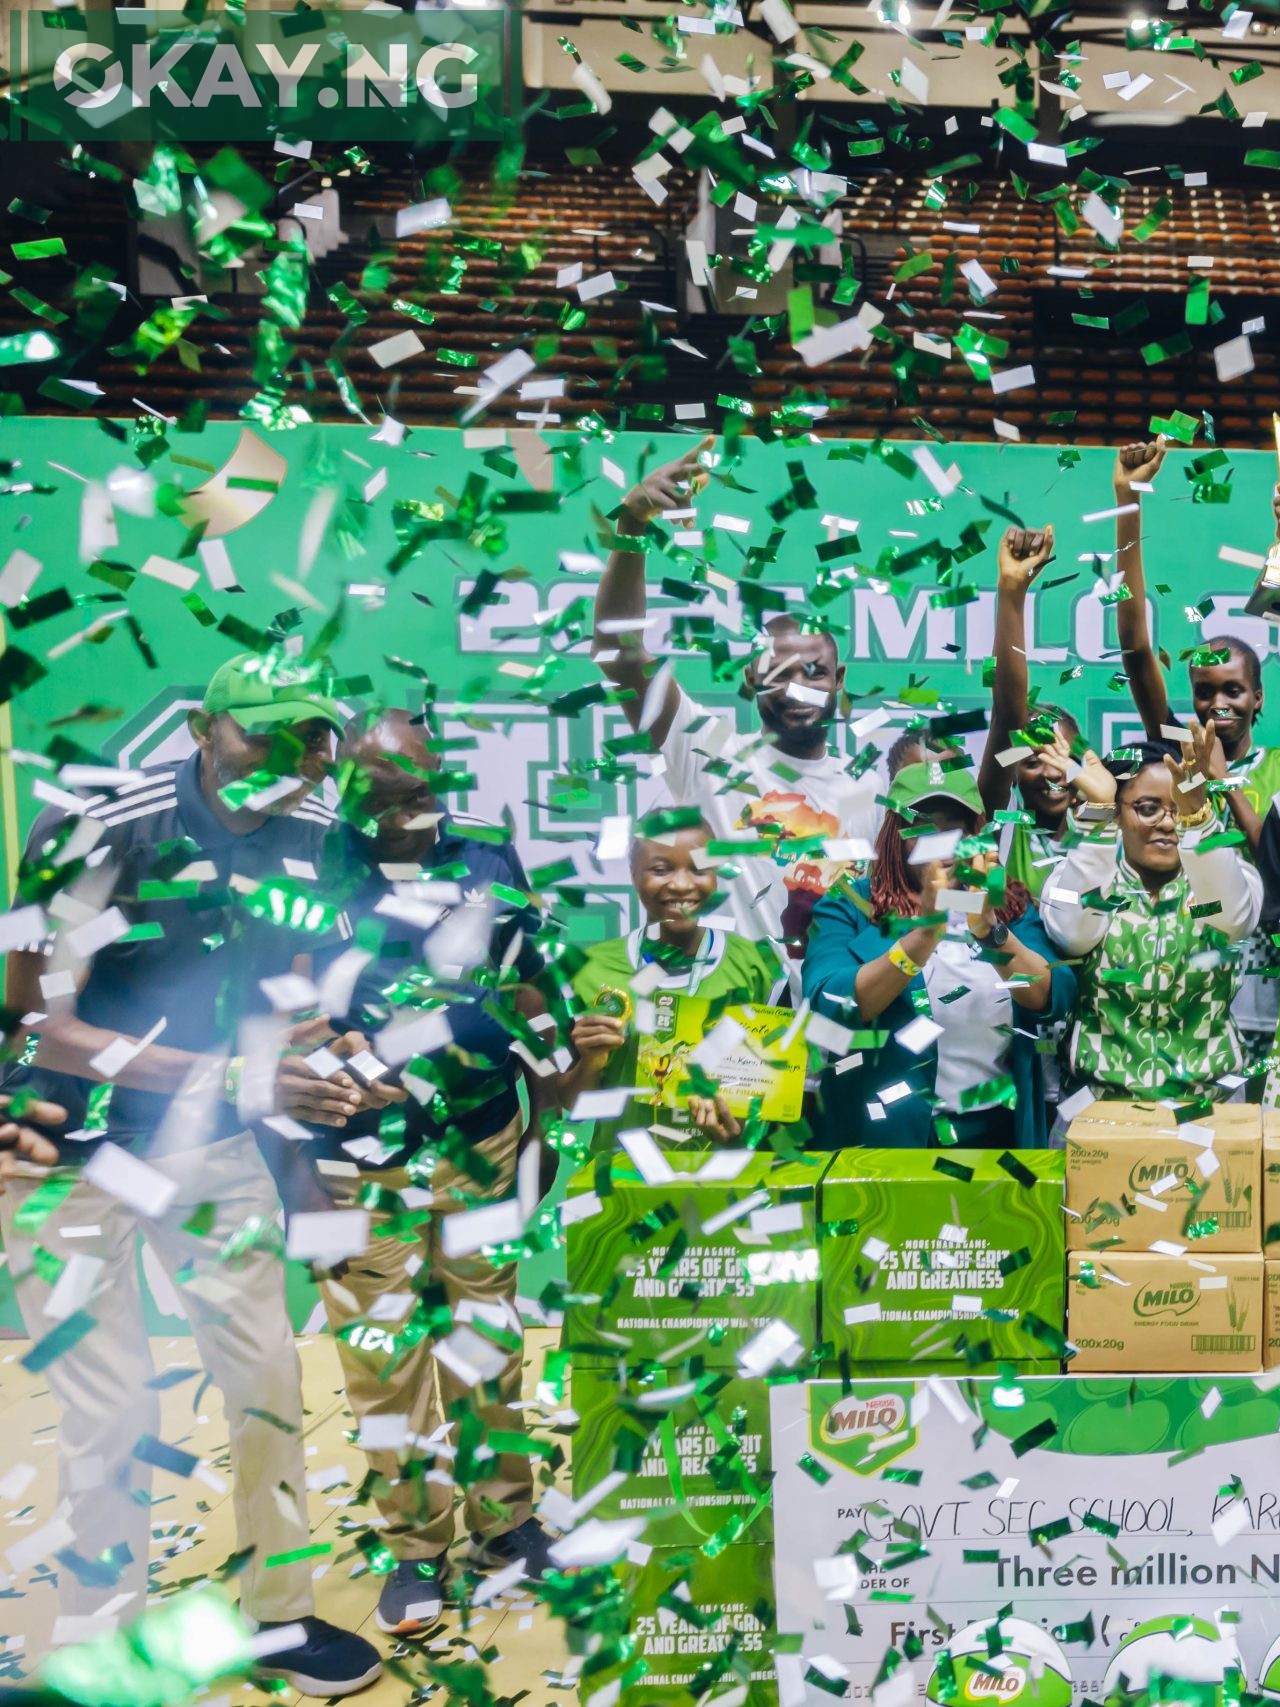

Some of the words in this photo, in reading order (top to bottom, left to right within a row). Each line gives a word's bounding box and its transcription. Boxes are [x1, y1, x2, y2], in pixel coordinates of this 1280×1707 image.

[1137, 1163, 1189, 1182] MILO
[702, 1257, 721, 1276] OF
[880, 1250, 899, 1269] 25
[633, 1278, 666, 1297] AND
[886, 1271, 918, 1290] AND
[920, 1270, 1004, 1289] GREATNESS
[1142, 1288, 1194, 1307] MILO
[617, 1317, 661, 1329] NATIONAL
[1074, 1337, 1125, 1350] 200x20g
[831, 1407, 898, 1431] MILO
[837, 1508, 863, 1519] PAY
[997, 1554, 1098, 1588] Three
[1111, 1551, 1236, 1587] million
[890, 1577, 910, 1589] OF
[636, 1616, 656, 1635] 25
[643, 1635, 675, 1655] AND
